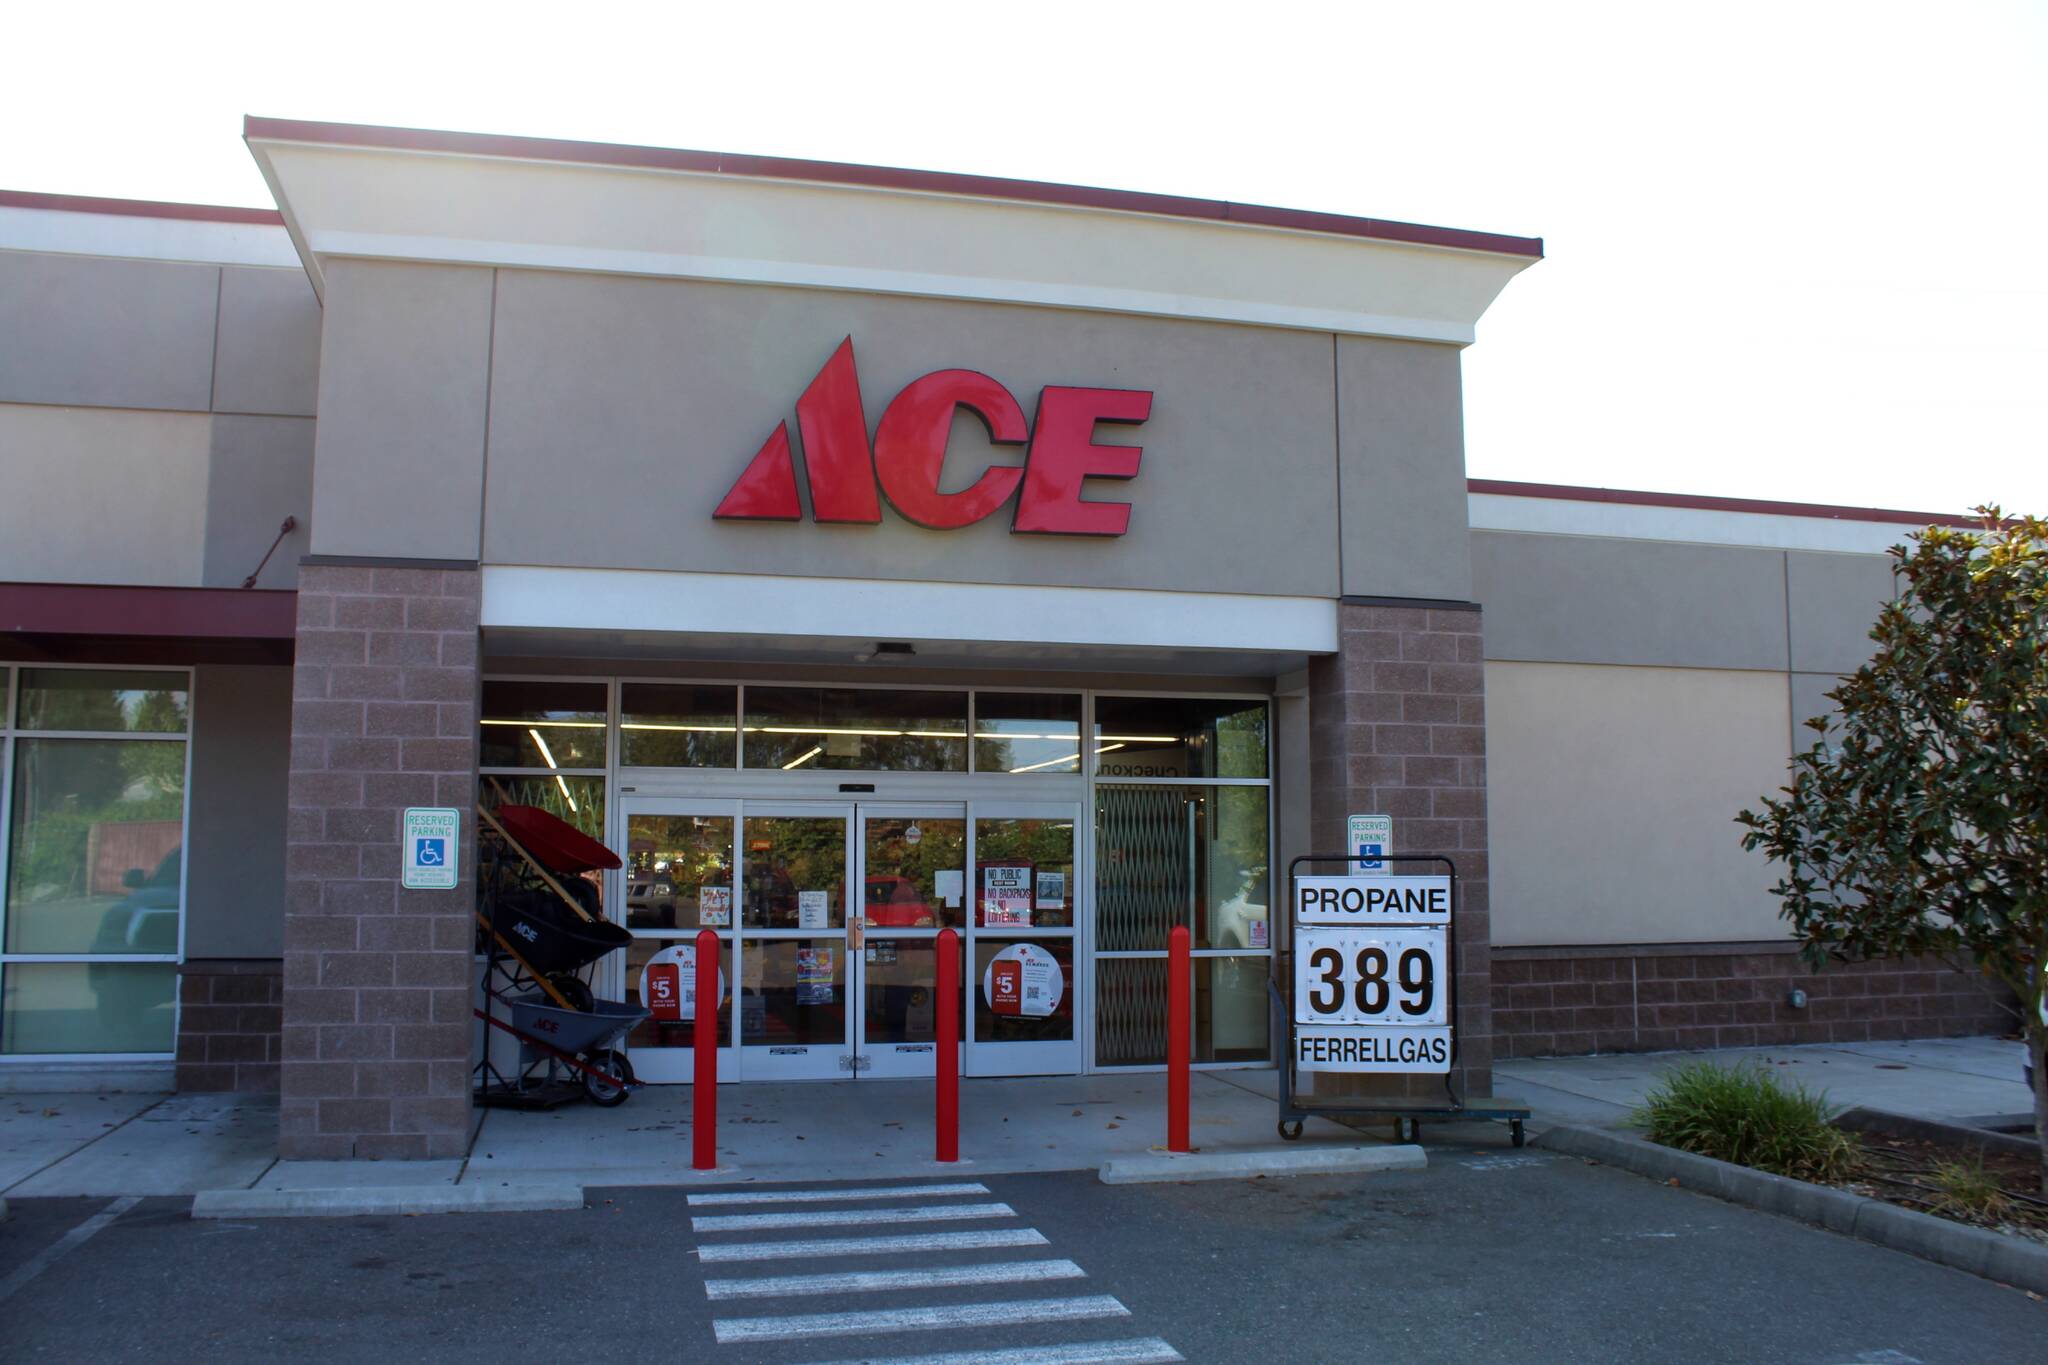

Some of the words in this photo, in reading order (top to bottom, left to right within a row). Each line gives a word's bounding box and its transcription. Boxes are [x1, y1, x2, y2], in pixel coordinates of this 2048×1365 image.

[712, 333, 1153, 537] ACE
[408, 815, 454, 826] RESERVED
[1351, 821, 1388, 831] RESERVED
[411, 826, 451, 837] PARKING
[1354, 833, 1387, 842] PARKING
[988, 869, 997, 880] NO
[1001, 869, 1022, 880] PUBLIC
[988, 888, 997, 899] NO
[999, 888, 1032, 899] BACKPACKS
[1300, 887, 1447, 913] PROPANE
[988, 911, 1021, 923] LOITERING
[512, 921, 539, 943] ACE
[652, 980, 671, 999] $5
[996, 976, 1013, 994] $5
[1309, 947, 1434, 1015] 389
[532, 1016, 560, 1034] ACE
[1300, 1037, 1447, 1064] FERRELLGAS
